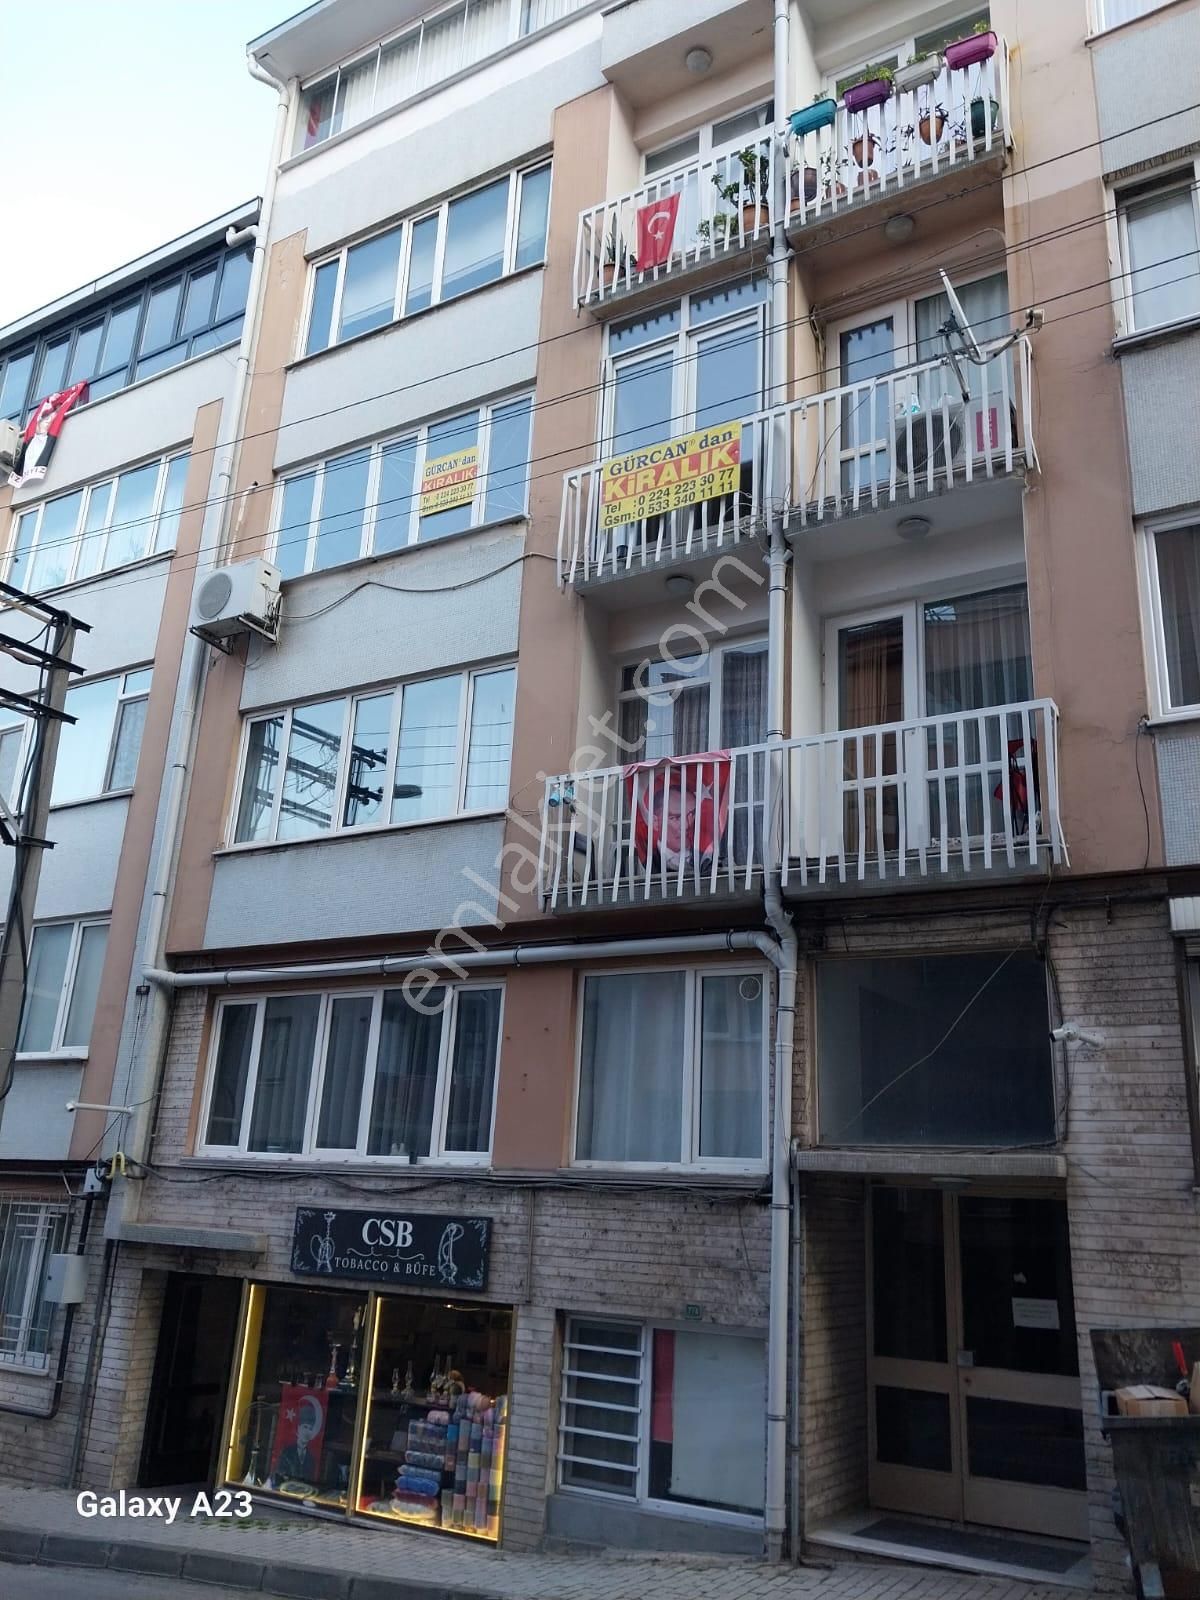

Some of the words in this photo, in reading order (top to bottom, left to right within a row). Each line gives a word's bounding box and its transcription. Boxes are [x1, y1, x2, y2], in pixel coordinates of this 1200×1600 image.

[698, 430, 734, 450] dan
[605, 501, 622, 515] Tel
[648, 487, 670, 502] 224
[674, 479, 697, 494] 223
[699, 473, 715, 487] 30
[719, 467, 735, 481] 77
[647, 499, 670, 515] 533
[673, 491, 696, 507] 340
[700, 486, 714, 499] 11
[719, 480, 734, 493] 11
[362, 1218, 413, 1248] CSB
[334, 1256, 389, 1272] TOBACCO
[392, 1262, 401, 1273] &
[405, 1260, 437, 1276] BÜFE
